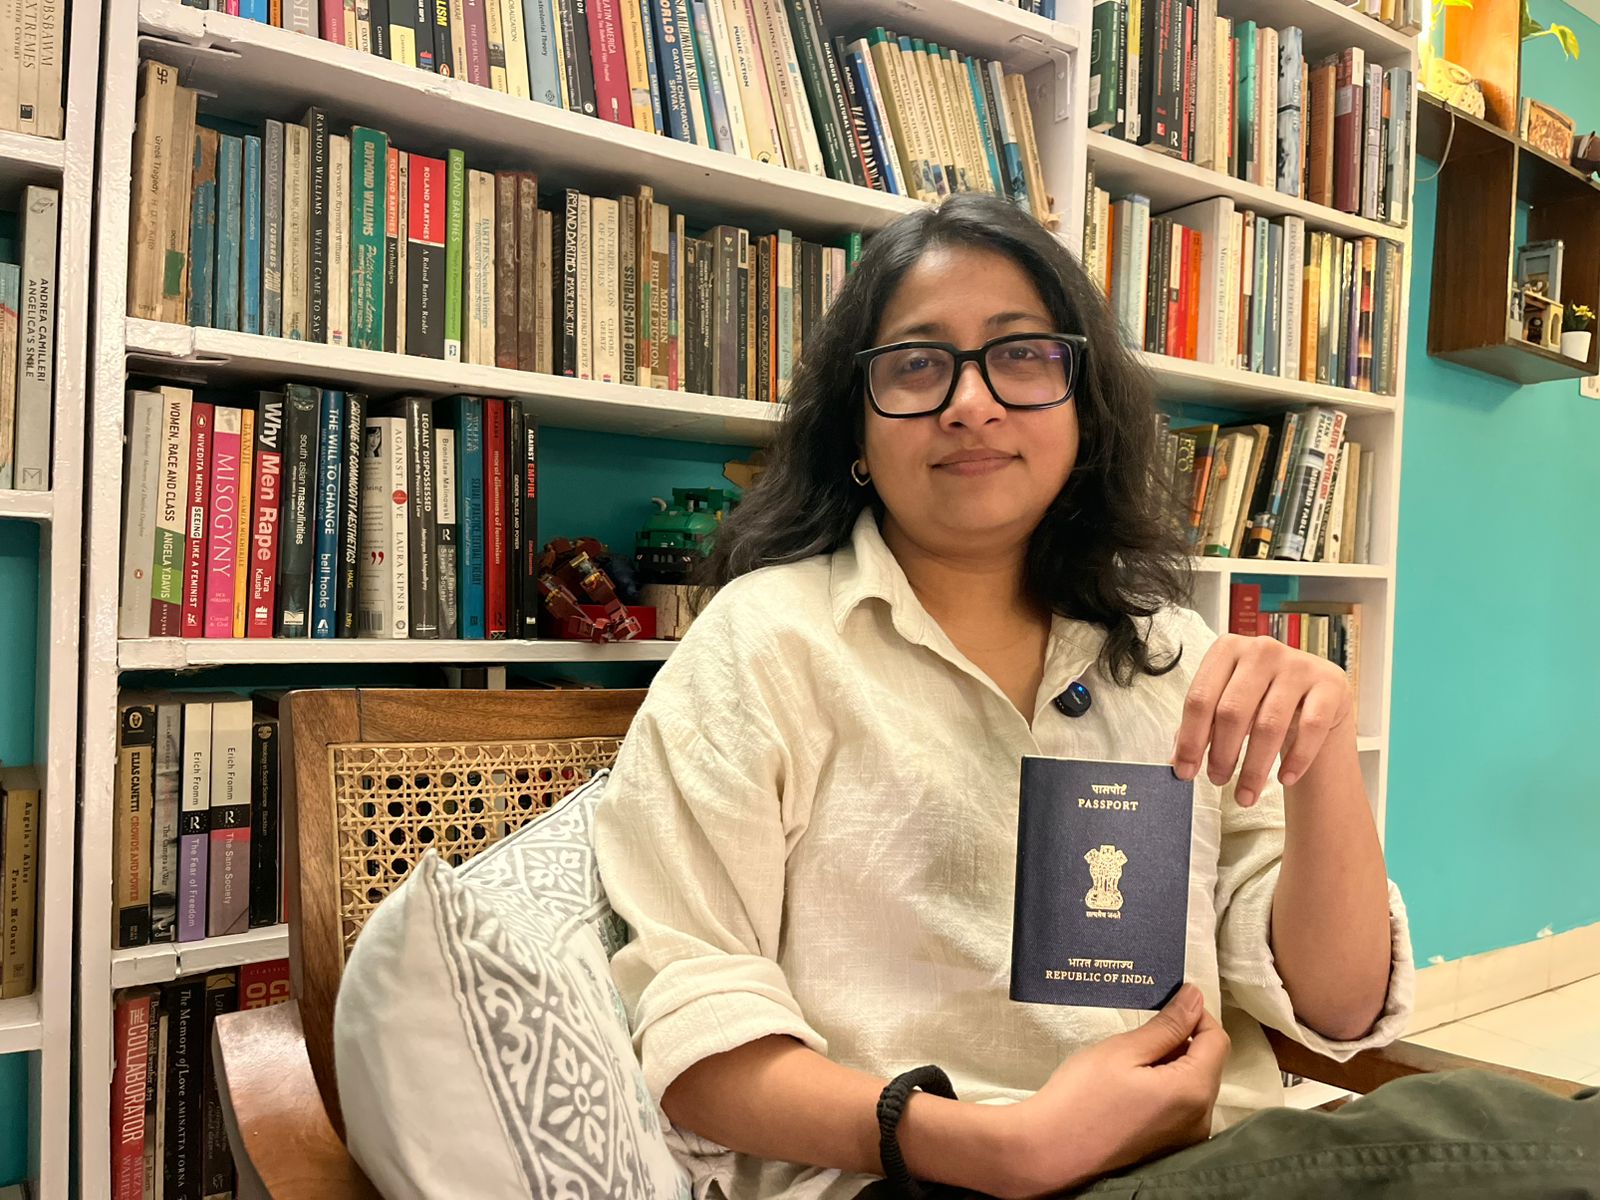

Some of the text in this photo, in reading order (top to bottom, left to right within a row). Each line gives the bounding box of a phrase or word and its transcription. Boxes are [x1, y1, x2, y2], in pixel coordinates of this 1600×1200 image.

[541, 35, 550, 56] Theory
[605, 21, 617, 54] AMERICA
[733, 26, 750, 88] PUBLIC ACTION
[672, 48, 683, 84] GAYATRI
[688, 71, 700, 91] SAID
[709, 60, 721, 95] AT LARGE
[772, 49, 789, 98] CULTURES
[844, 65, 857, 95] RACISM
[669, 80, 680, 111] SPIVAK
[823, 42, 858, 159] DIALOGUES ON CULTURAL STUDIES
[315, 113, 325, 163] RAYMOND
[1170, 130, 1179, 147] R
[150, 136, 163, 195] Greek Tragedy
[389, 158, 397, 193] ROLAND
[452, 156, 462, 197] ROLAND
[314, 166, 324, 216] WILLIAMS
[362, 141, 375, 237] RAYMOND WILLIAMS
[314, 229, 323, 257] WHAT
[422, 203, 430, 240] BARTHES
[451, 199, 461, 242] BARTHES
[388, 241, 396, 284] Mythologies
[580, 200, 588, 294] LOCAL KNOWLEDGE
[598, 236, 606, 287] CULTURES
[313, 267, 322, 295] CAME
[421, 283, 429, 308] Barthes
[1287, 223, 1298, 348] LIVING WITH THE GODS
[312, 315, 321, 334] SAY
[313, 299, 322, 312] TO
[421, 310, 429, 335] Reader
[650, 260, 660, 369] BRITISH FICTION
[659, 287, 669, 344] MODERN
[761, 253, 769, 386] SUSAN SONTAG ON PHOTOGRAPHY
[1217, 291, 1226, 341] the Limits
[26, 280, 37, 378] ANGELICA'S SMILE
[37, 278, 49, 382] ANDREA CAMILLERI
[599, 320, 607, 352] GEERTZ
[607, 318, 615, 357] CLIFFORD
[623, 343, 635, 383] Claude
[1323, 416, 1333, 437] GYAN
[1330, 414, 1344, 449] CREATIVE
[164, 402, 181, 522] WOMEN, RACE AND CLASS
[324, 409, 339, 535] THE WILL TO CHANGE
[395, 428, 404, 477] AGAINST
[421, 413, 433, 512] LEGALLY DISPOSSESSED
[527, 429, 535, 498] AGAINST EMPIRE
[255, 402, 283, 561] Why Men Rape
[296, 434, 309, 546] south asian masculinities
[346, 400, 361, 565] CRITIQUE OF COMMODITY AESTHETICS
[442, 438, 451, 520] Bronislaw Malinowski
[1304, 468, 1320, 506] MUMBAI
[189, 433, 205, 609] NIVEDITA MENON SEEING LIKE A FEMINIST
[212, 452, 234, 578] MISOGYNY
[442, 528, 451, 541] R
[162, 531, 173, 566] ANGELA
[396, 531, 405, 611] LAURA KIPNIS
[447, 548, 455, 562] Sex
[254, 568, 265, 600] Kaushal
[263, 575, 272, 593] Tara
[319, 553, 331, 609] bell hooks
[346, 569, 354, 590] HAUG
[440, 575, 448, 602] Society
[191, 751, 203, 806] Erich Fromm
[226, 747, 236, 800] Erich Fromm
[1091, 783, 1128, 795] पासपोर्ट
[129, 752, 141, 871] ELIAS CANETTI CROWDS AND
[1078, 798, 1139, 810] PASSPORT
[22, 802, 33, 884] Angela's Ashes
[11, 869, 20, 903] Frank
[187, 838, 200, 927] The Fear of Freedom
[223, 832, 235, 905] The Sane Society
[1045, 969, 1155, 985] REPUBLIC OF INDIA
[1068, 958, 1134, 970] भारत गणराज्य
[129, 1008, 145, 1025] THE
[175, 990, 191, 1097] The Memory of Love
[121, 1023, 149, 1144] COLLABORATOR
[177, 1100, 186, 1188] AMINATTA FORNA
